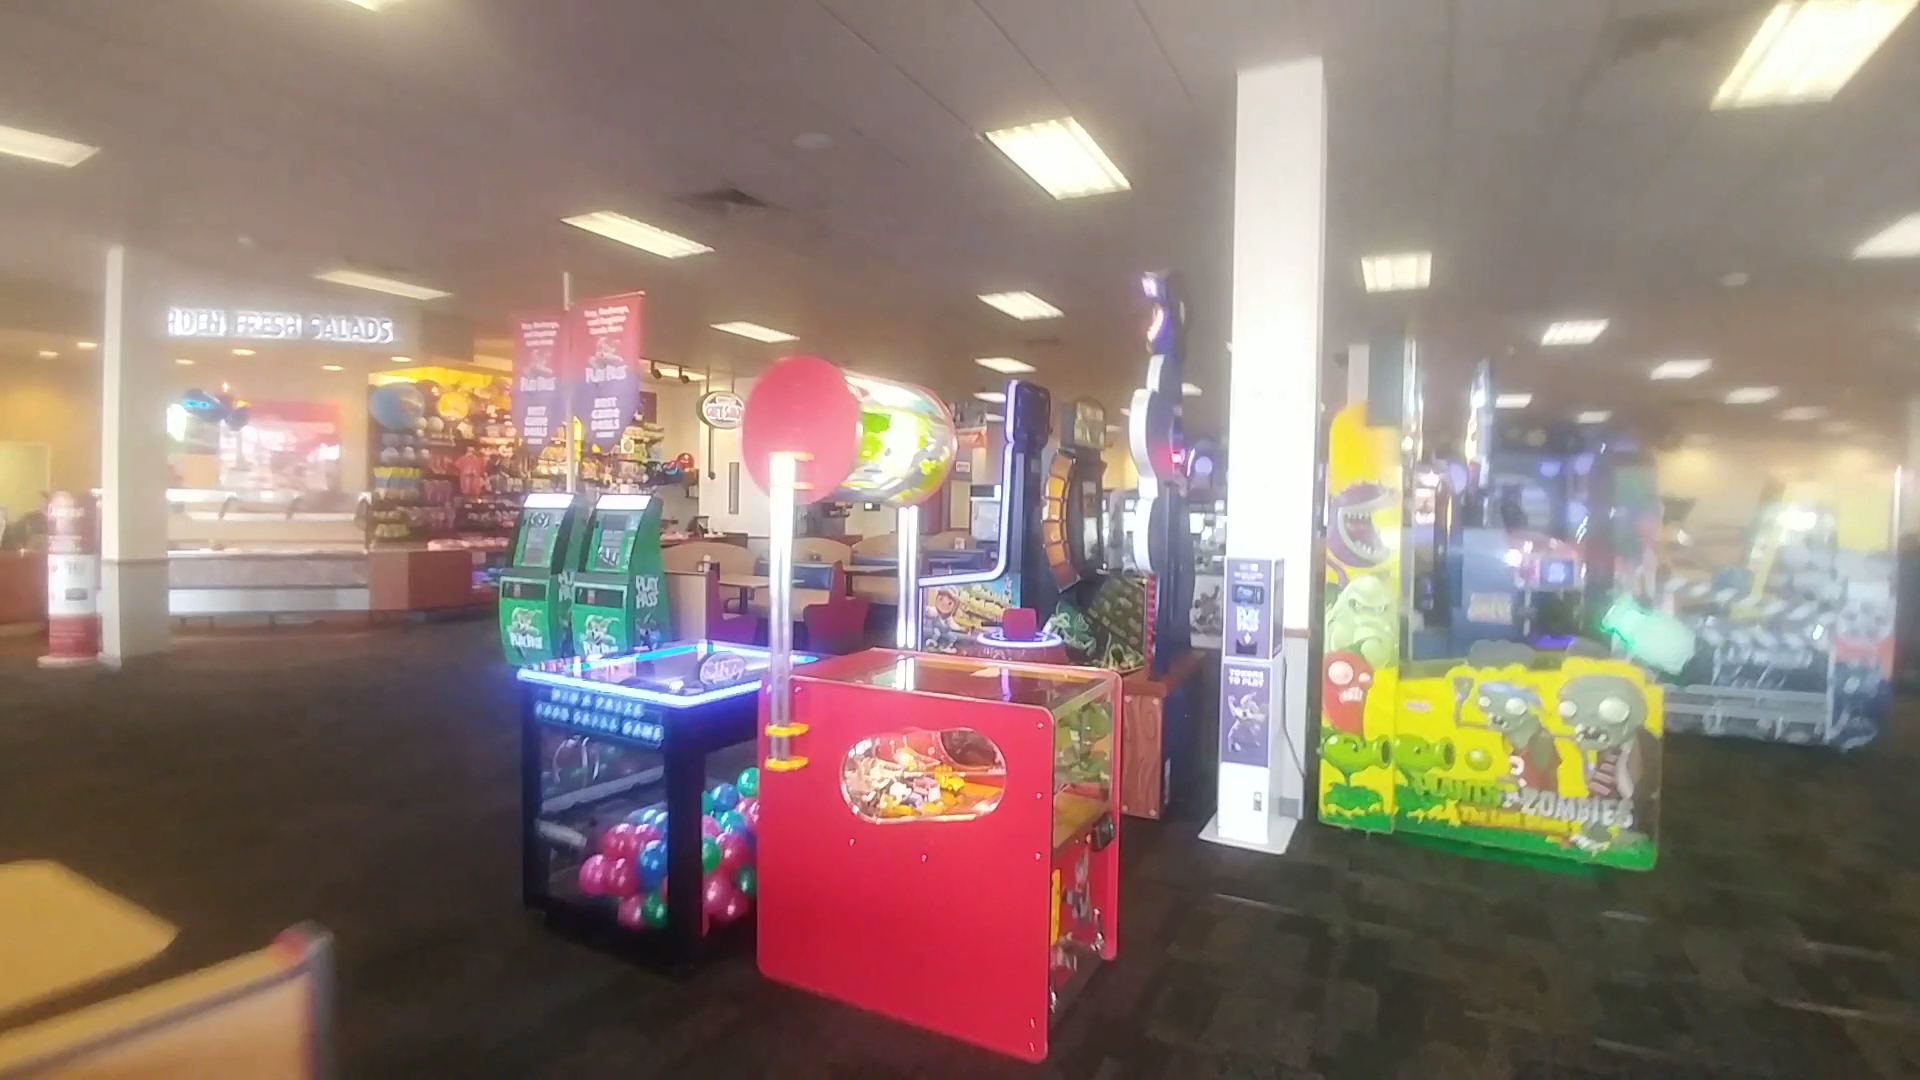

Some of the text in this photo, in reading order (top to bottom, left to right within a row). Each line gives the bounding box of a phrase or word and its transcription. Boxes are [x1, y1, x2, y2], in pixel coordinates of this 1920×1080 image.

[236, 312, 302, 340] FRESH
[310, 315, 394, 344] SALADS
[635, 575, 659, 593] PLAY
[635, 592, 659, 609] PASS
[1520, 786, 1634, 830] ZOMBIES
